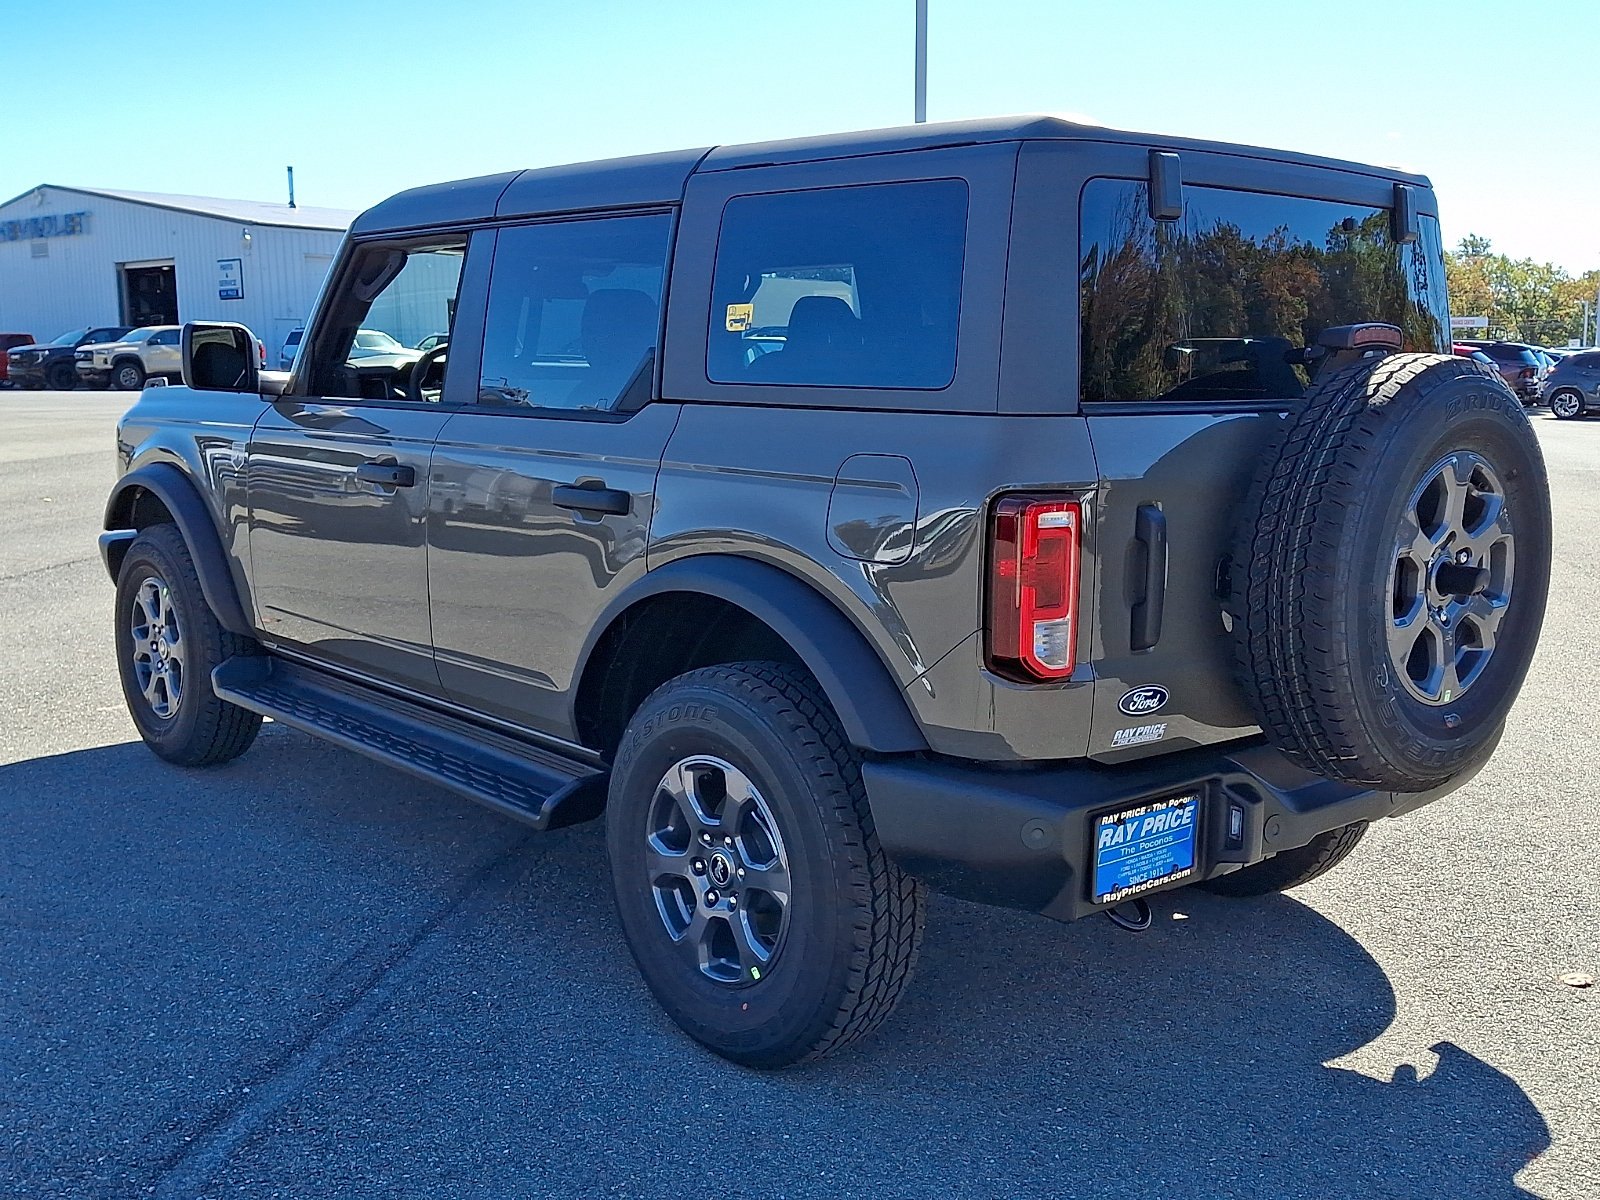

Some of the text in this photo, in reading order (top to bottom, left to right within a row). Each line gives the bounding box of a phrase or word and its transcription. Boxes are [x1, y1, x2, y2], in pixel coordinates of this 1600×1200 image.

[1129, 690, 1161, 711] Ford
[1113, 722, 1167, 740] RAY PRICE
[1101, 814, 1119, 826] RAY
[1120, 807, 1149, 820] PRICE
[1152, 802, 1167, 811] The
[1098, 804, 1195, 848] RAY PRICE
[1120, 834, 1174, 856] The Poconos
[1102, 868, 1191, 904] RayPriceCars.com
[1129, 866, 1165, 885] SINCE 1913
